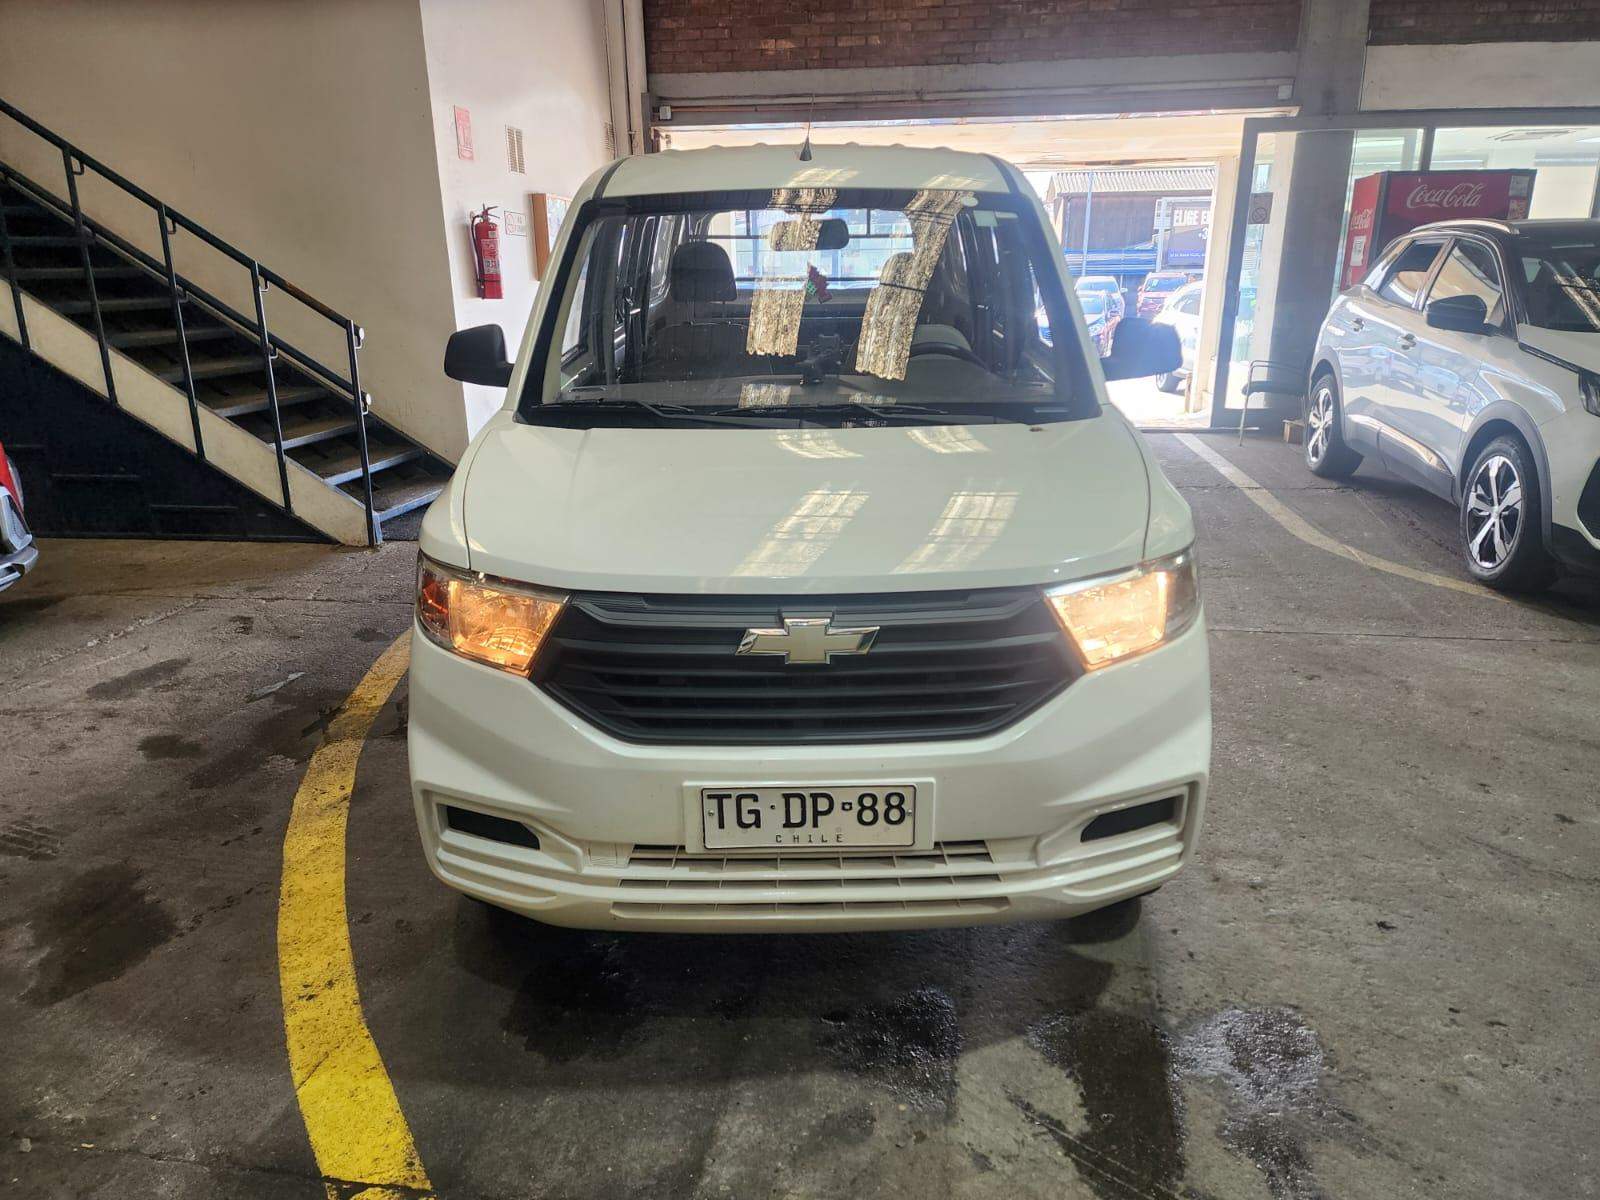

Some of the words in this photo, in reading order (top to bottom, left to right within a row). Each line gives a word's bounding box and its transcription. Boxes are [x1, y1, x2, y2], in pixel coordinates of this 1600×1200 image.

[1406, 182, 1486, 209] Coca-Cola
[1173, 209, 1199, 226] ELIGE
[775, 833, 844, 844] CHILE
